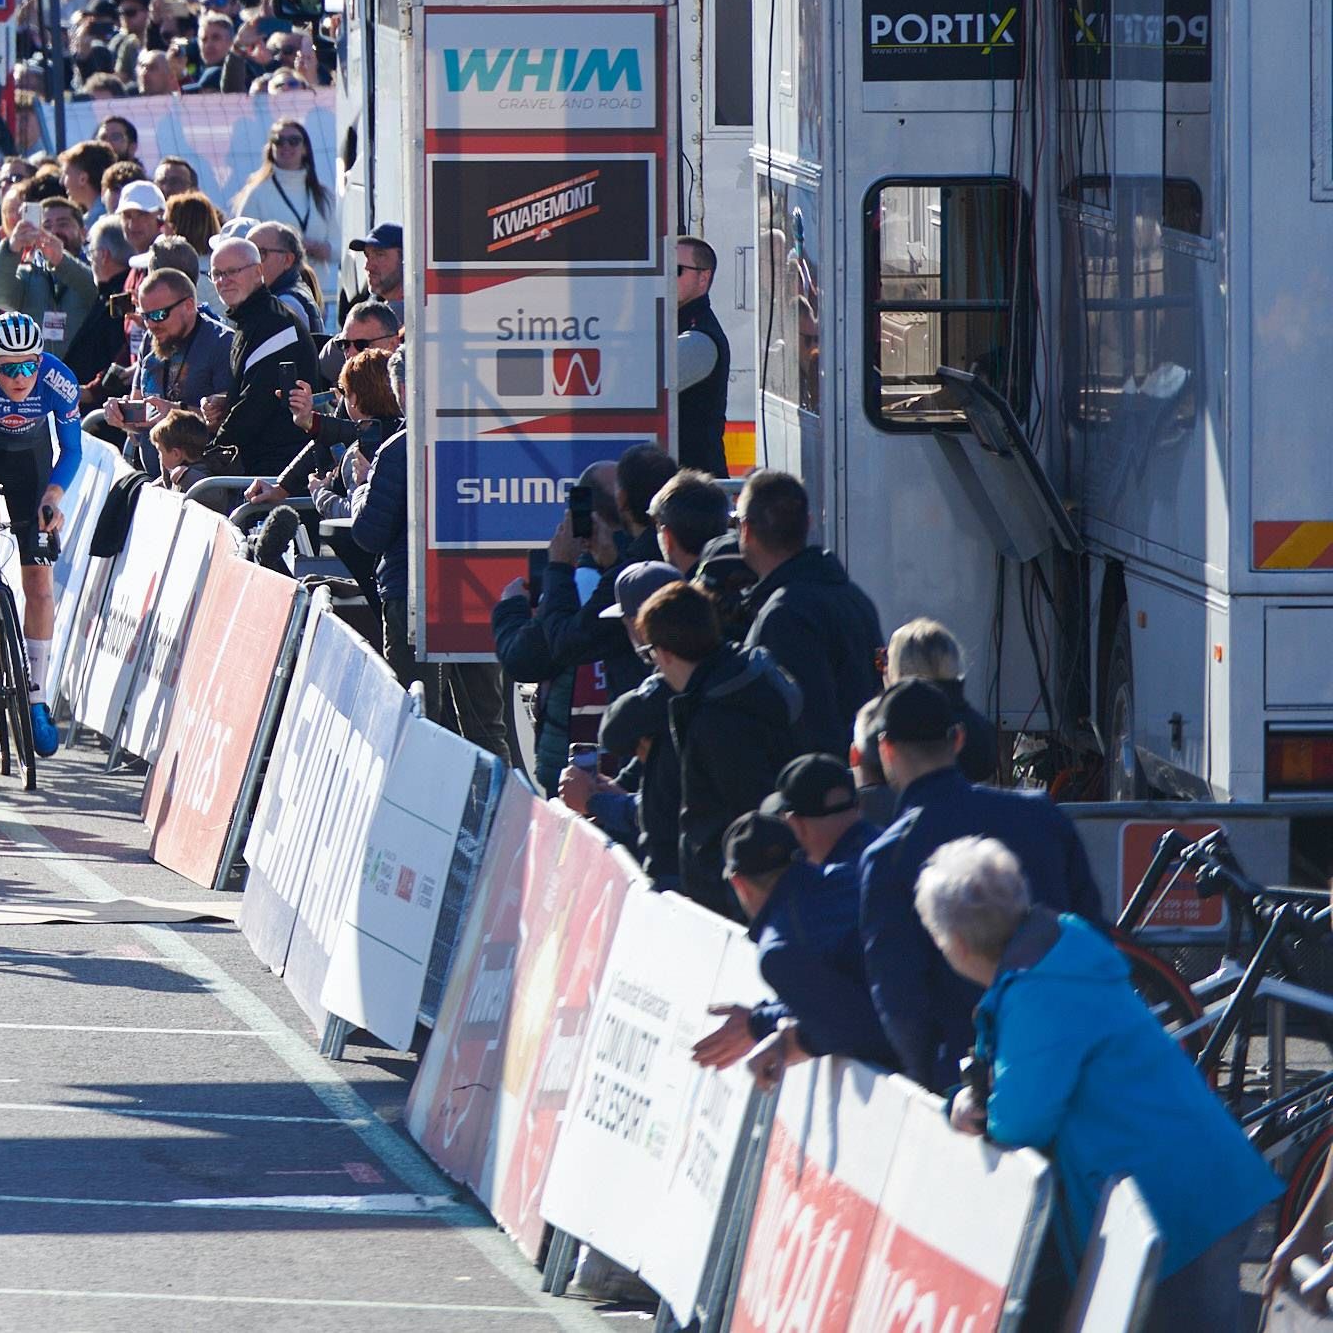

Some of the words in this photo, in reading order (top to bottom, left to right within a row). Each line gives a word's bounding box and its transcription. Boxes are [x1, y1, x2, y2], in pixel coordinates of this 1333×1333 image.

[870, 8, 1017, 53] PORTIX
[442, 48, 642, 93] WHIM
[497, 98, 556, 110] GRAVEL
[561, 98, 594, 110] AND
[598, 98, 642, 110] ROAD
[492, 180, 597, 241] KWAREMONT
[496, 308, 601, 341] simac
